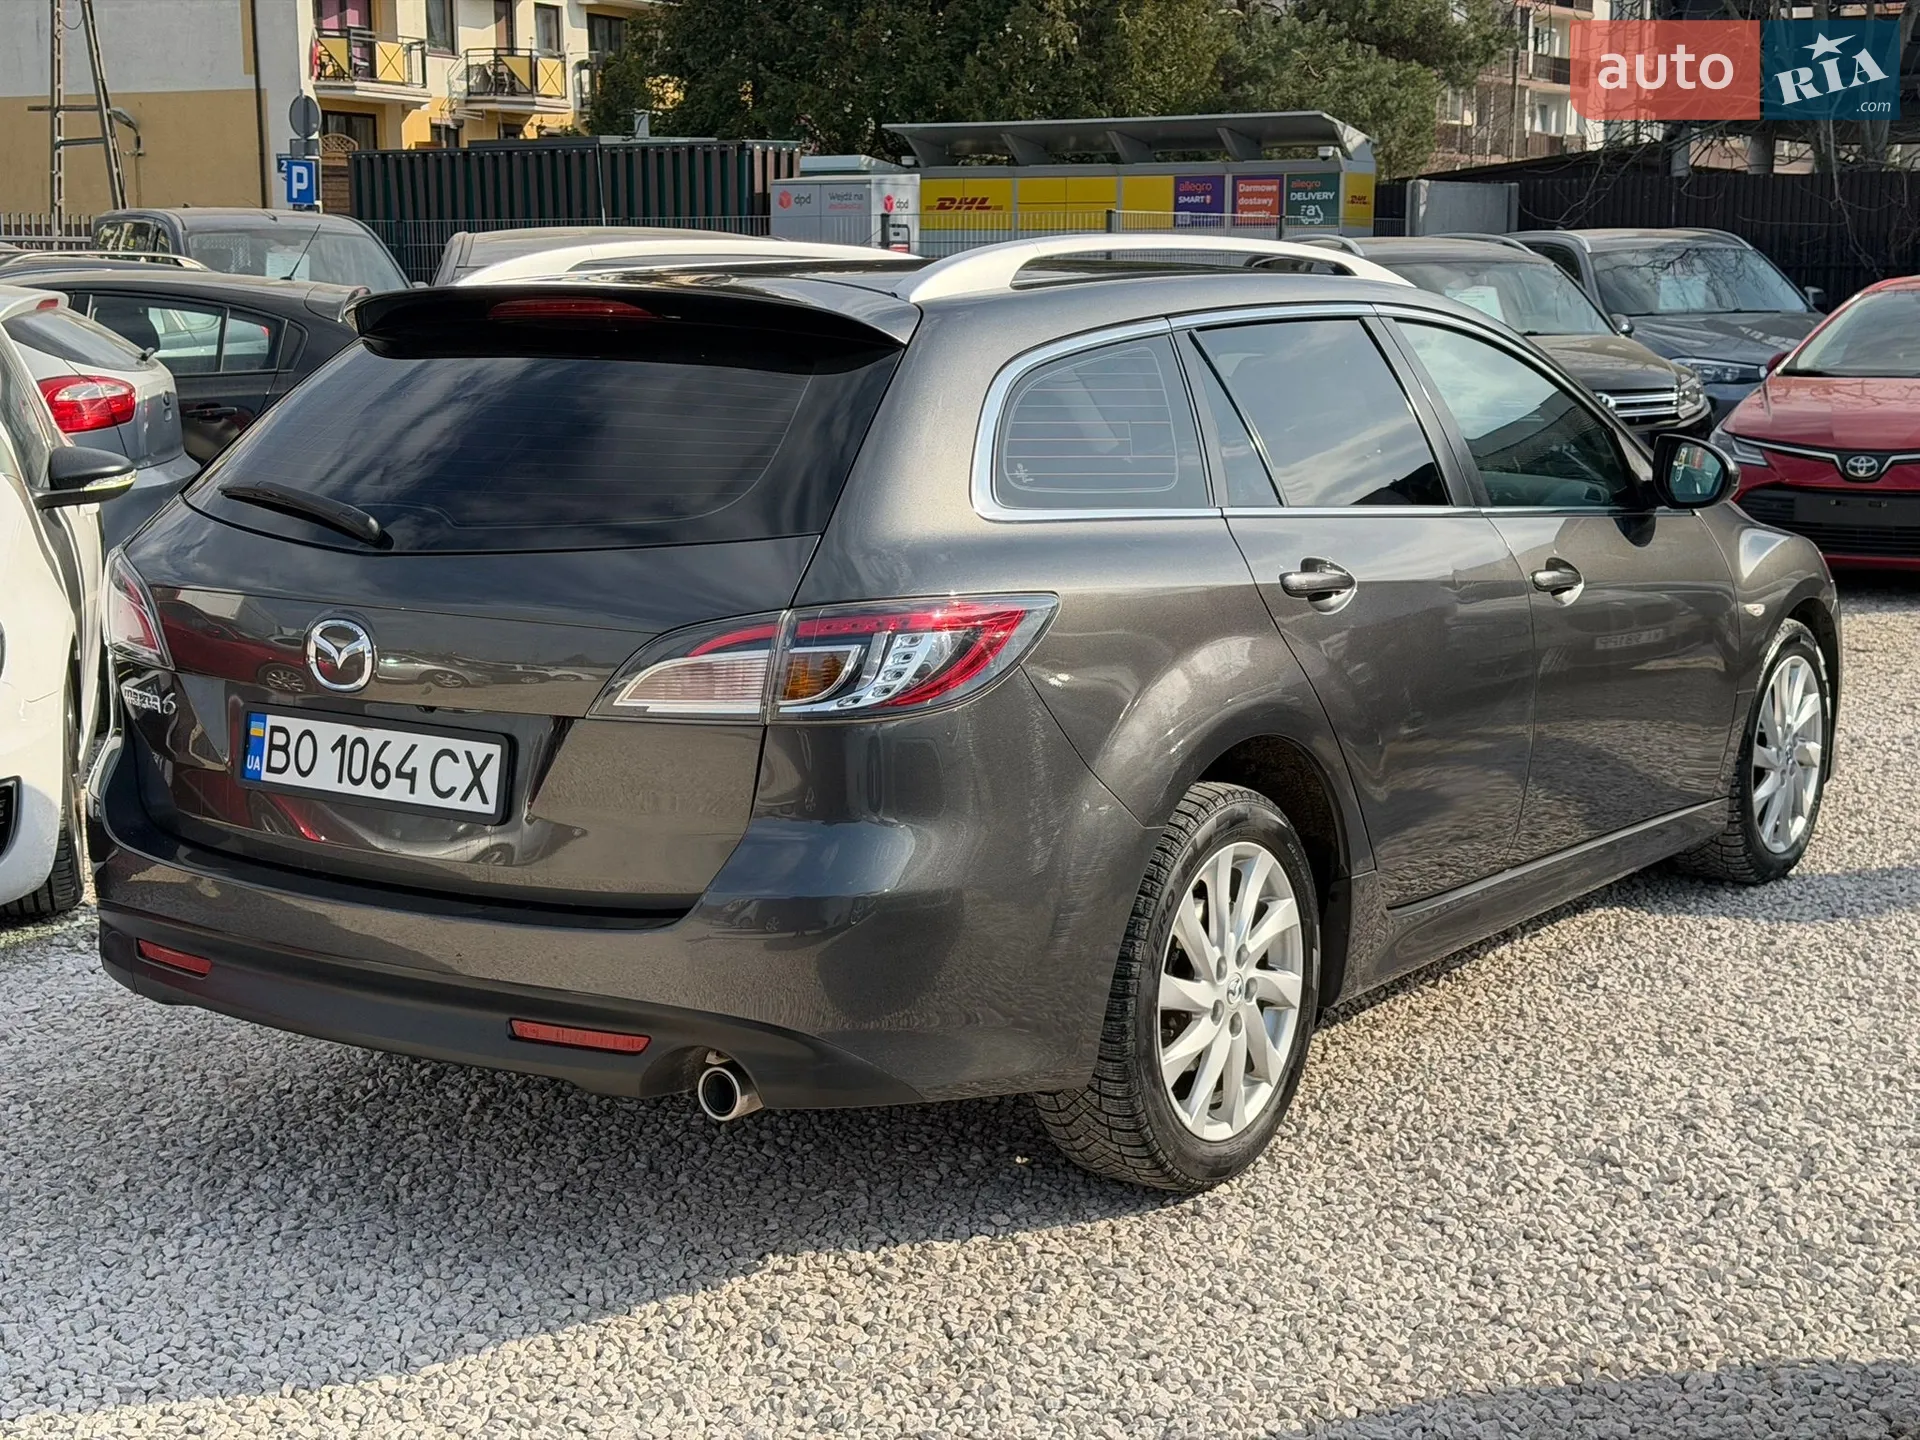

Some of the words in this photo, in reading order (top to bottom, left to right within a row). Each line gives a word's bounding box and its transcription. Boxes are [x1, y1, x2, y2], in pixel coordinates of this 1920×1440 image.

[291, 165, 308, 199] P
[1179, 181, 1212, 194] allegro
[1238, 183, 1277, 193] Darmowe
[1291, 179, 1321, 190] allegro
[793, 193, 812, 207] dpd
[1238, 197, 1273, 207] dostawy
[1290, 191, 1335, 201] DELIVERY
[896, 198, 909, 211] dpd
[936, 196, 993, 211] DHL
[246, 754, 260, 771] UA
[265, 725, 318, 778] BO
[330, 734, 419, 795] 1064
[429, 748, 494, 805] CX
